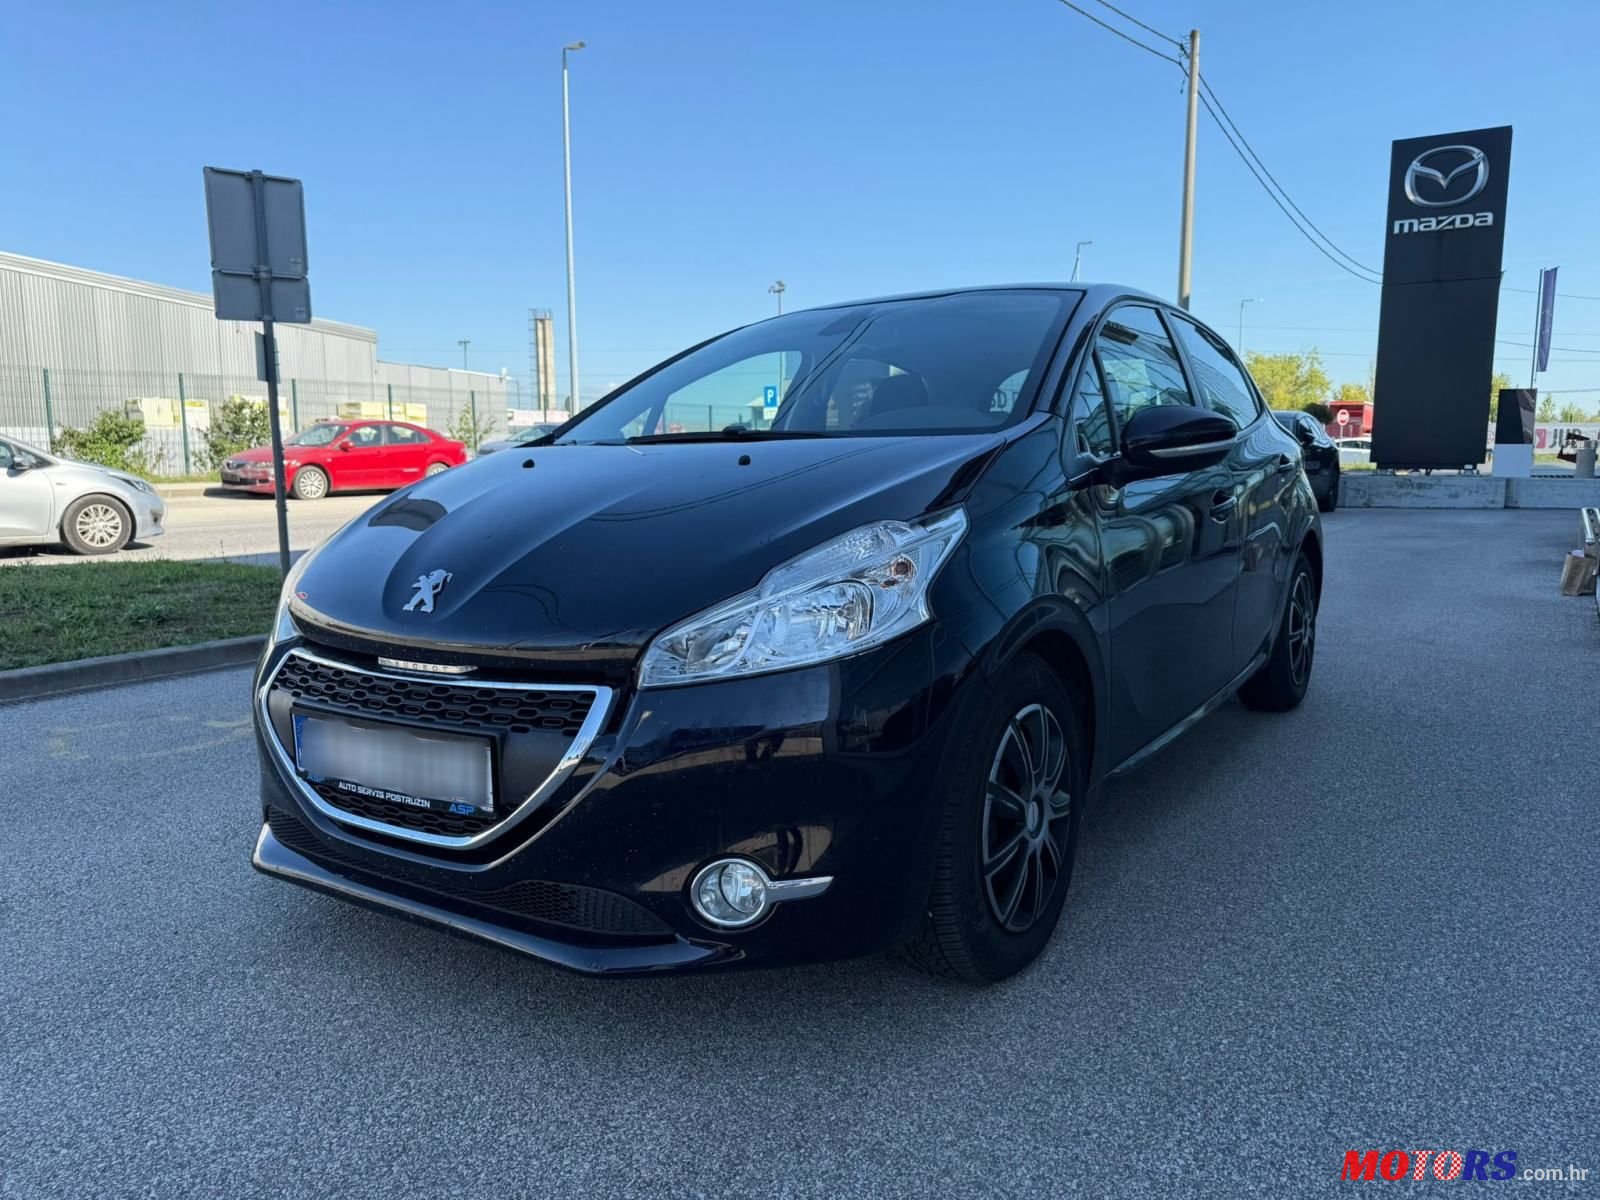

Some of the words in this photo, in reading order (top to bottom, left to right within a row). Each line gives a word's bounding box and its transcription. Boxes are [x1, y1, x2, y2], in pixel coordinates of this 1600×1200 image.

[1393, 211, 1494, 234] mazda
[766, 389, 774, 404] P
[338, 781, 357, 793] AUTO
[358, 786, 384, 799] SERVIS
[449, 803, 475, 815] ASP
